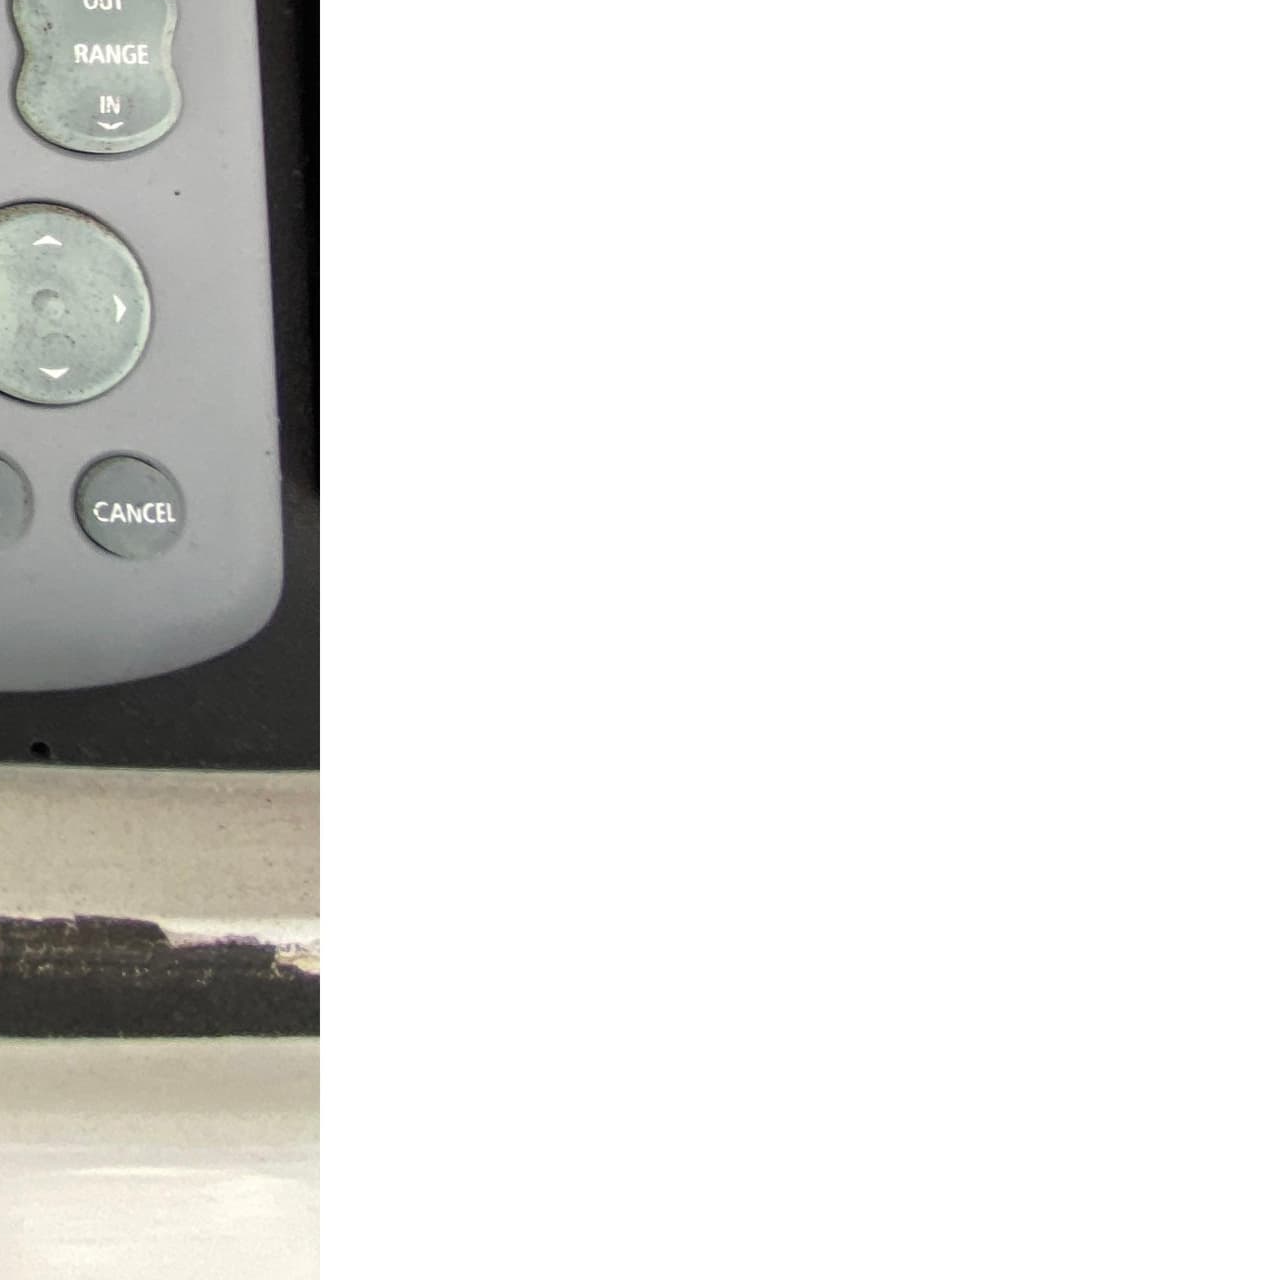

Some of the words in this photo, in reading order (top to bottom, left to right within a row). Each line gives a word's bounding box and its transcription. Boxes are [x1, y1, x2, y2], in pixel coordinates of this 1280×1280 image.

[73, 43, 149, 65] RANGE
[99, 95, 121, 114] IN
[93, 501, 176, 523] CANCEL
